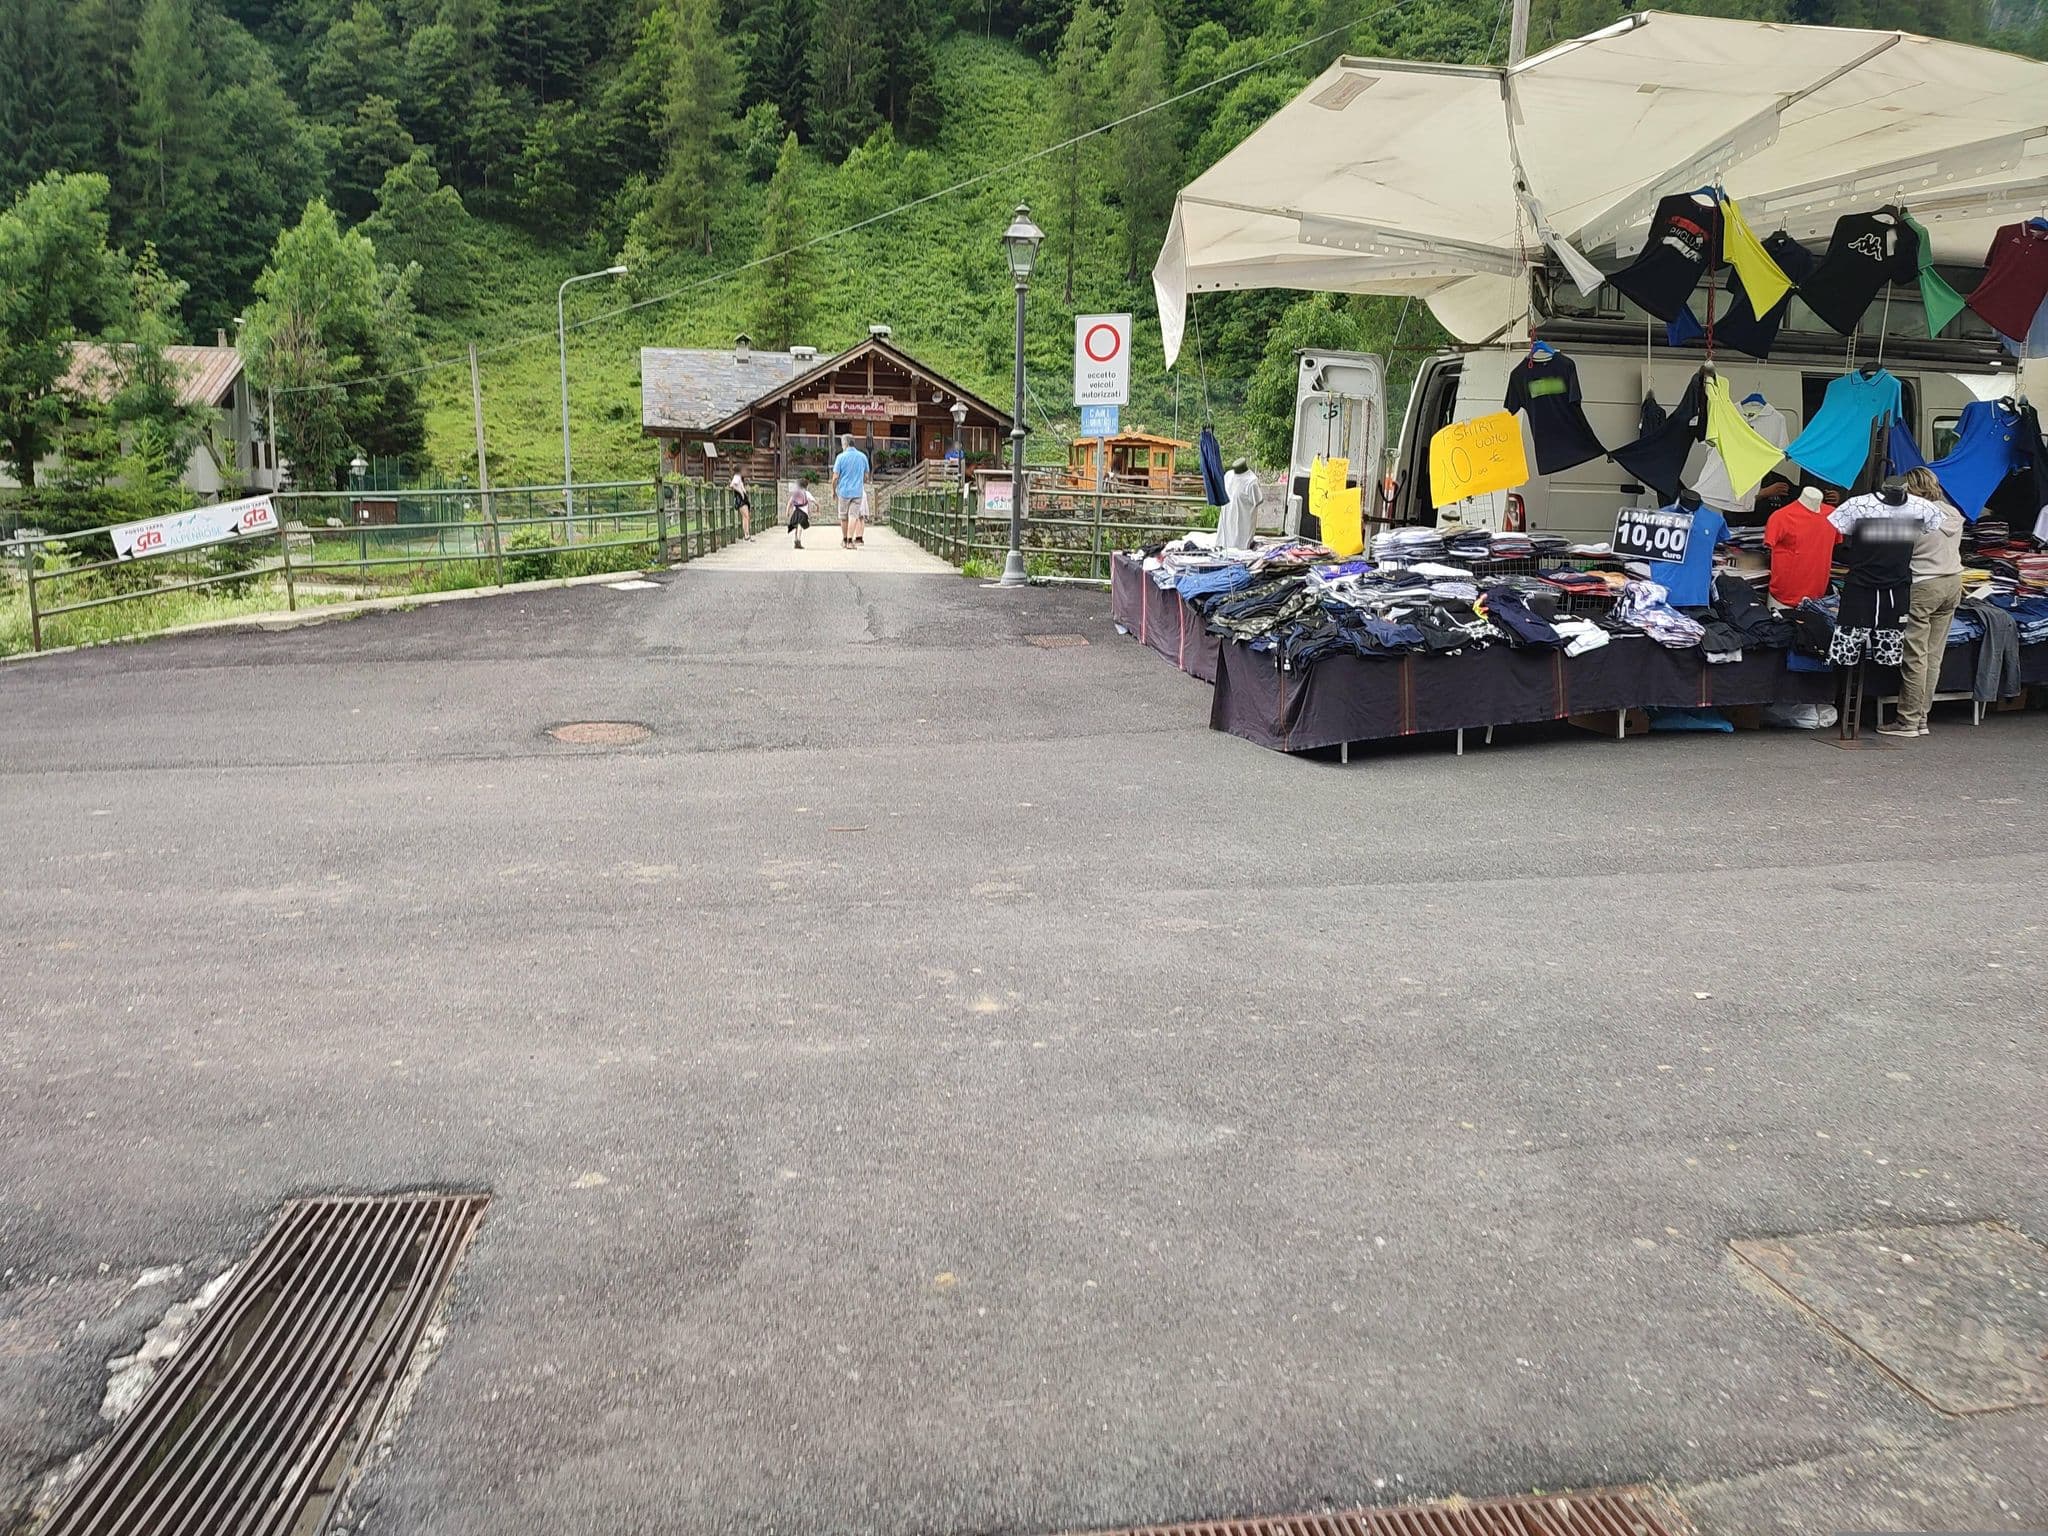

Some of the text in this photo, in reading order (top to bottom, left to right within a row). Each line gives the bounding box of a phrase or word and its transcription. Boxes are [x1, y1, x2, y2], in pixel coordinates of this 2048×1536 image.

[1087, 371, 1117, 379] eccetto
[1089, 380, 1114, 389] veicoli
[1081, 389, 1121, 399] autorizzati
[243, 508, 268, 528] gta
[1620, 511, 1629, 522] A
[136, 531, 162, 551] gta
[1618, 522, 1686, 552] 10,00
